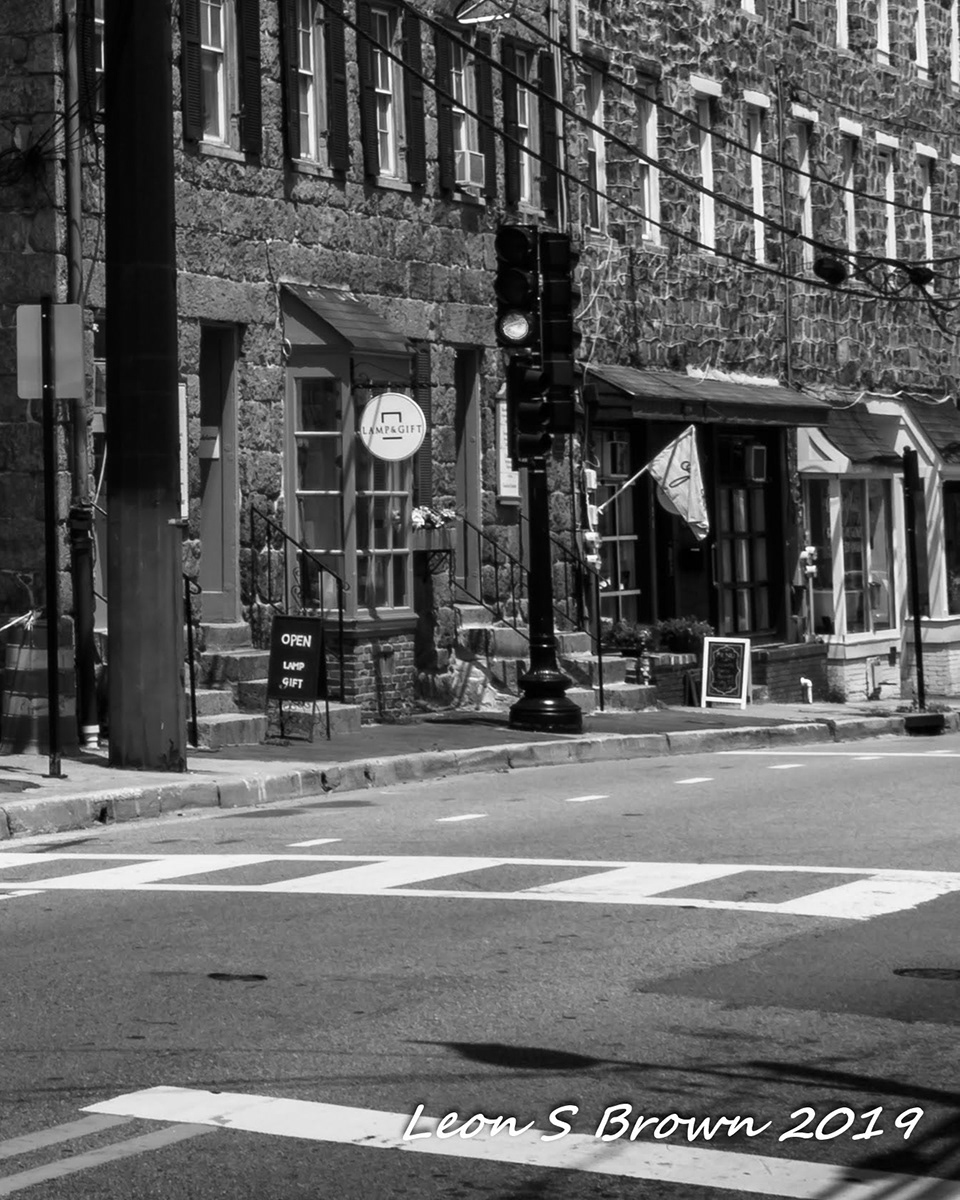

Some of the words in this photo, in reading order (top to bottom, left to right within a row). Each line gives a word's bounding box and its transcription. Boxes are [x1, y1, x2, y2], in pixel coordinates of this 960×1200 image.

[281, 633, 312, 647] OPEN
[283, 661, 305, 671] LAMP
[281, 677, 304, 689] GIFT
